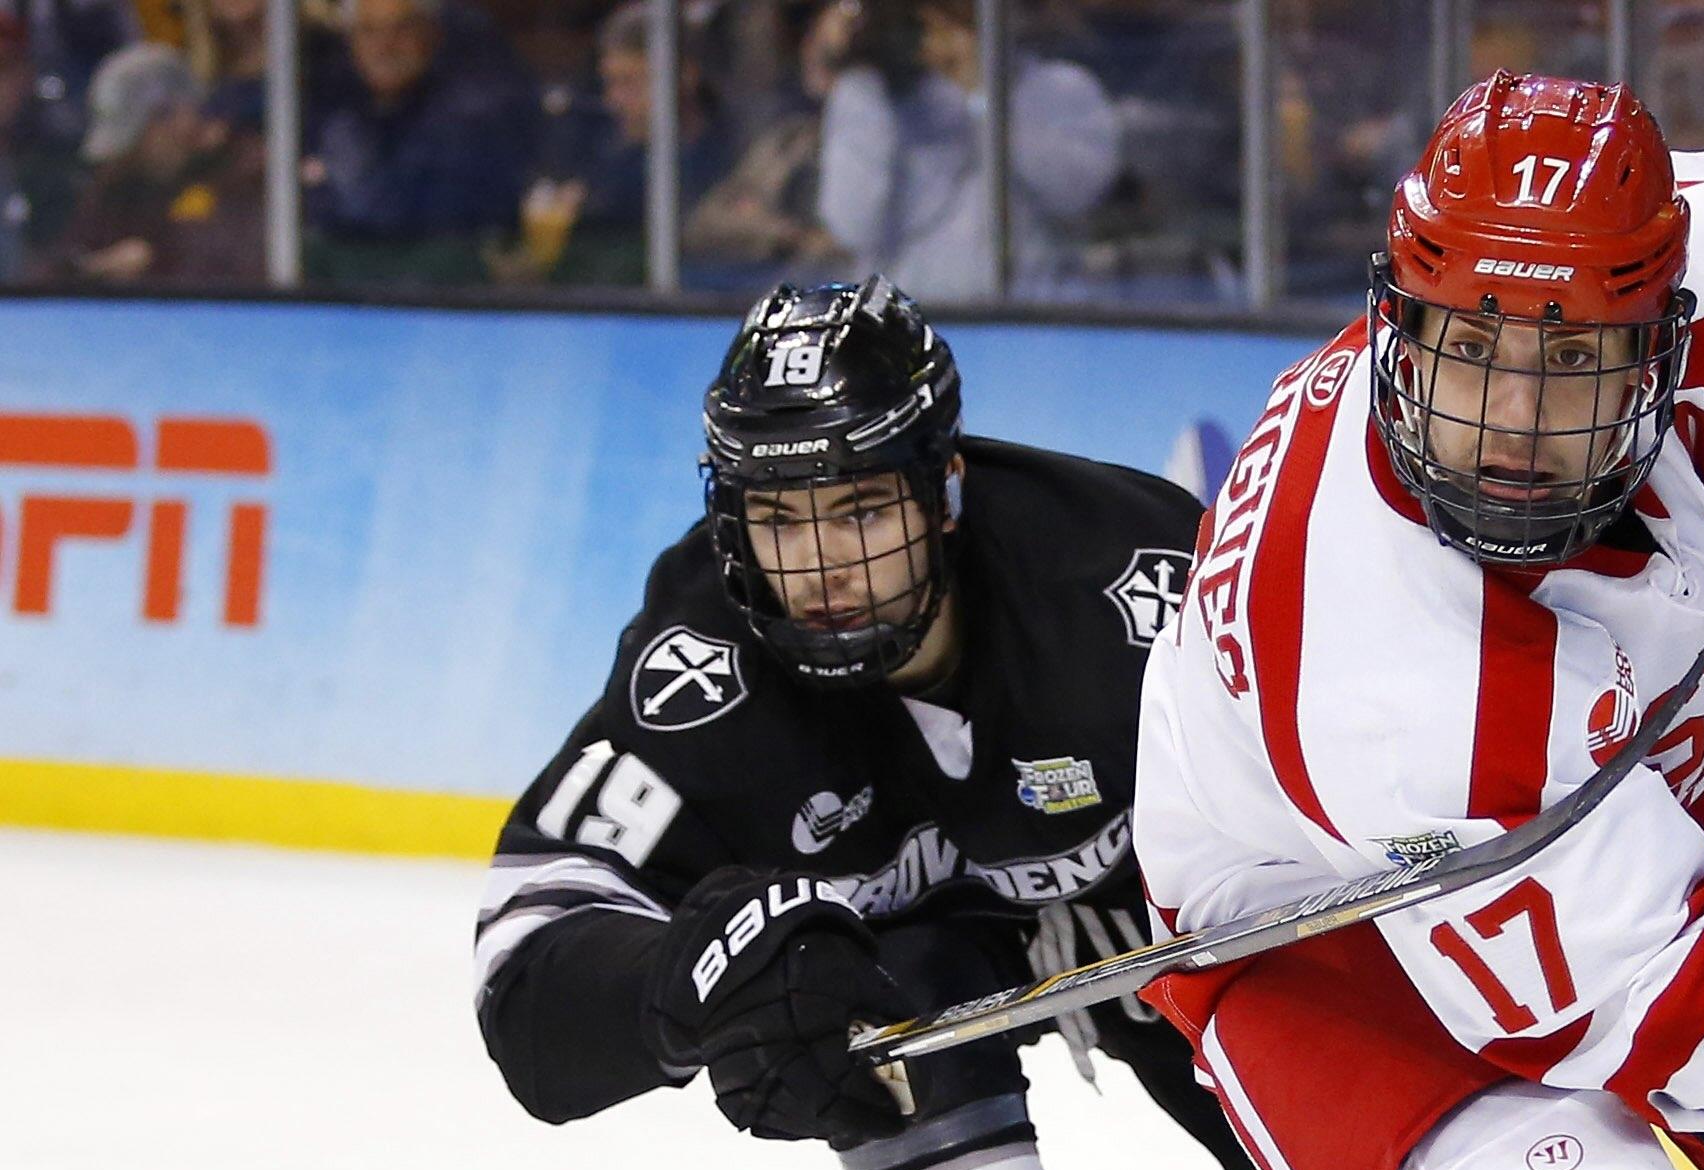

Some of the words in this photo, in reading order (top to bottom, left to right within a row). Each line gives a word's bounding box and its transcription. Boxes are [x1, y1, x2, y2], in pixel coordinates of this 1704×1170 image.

[1511, 154, 1571, 205] 17
[1474, 257, 1574, 282] BAUER
[763, 346, 824, 388] 19
[751, 438, 830, 458] BAUER
[536, 740, 682, 869] 19
[1382, 832, 1459, 856] FROZEN
[691, 876, 862, 1004] BAU
[1430, 876, 1578, 1035] 17
